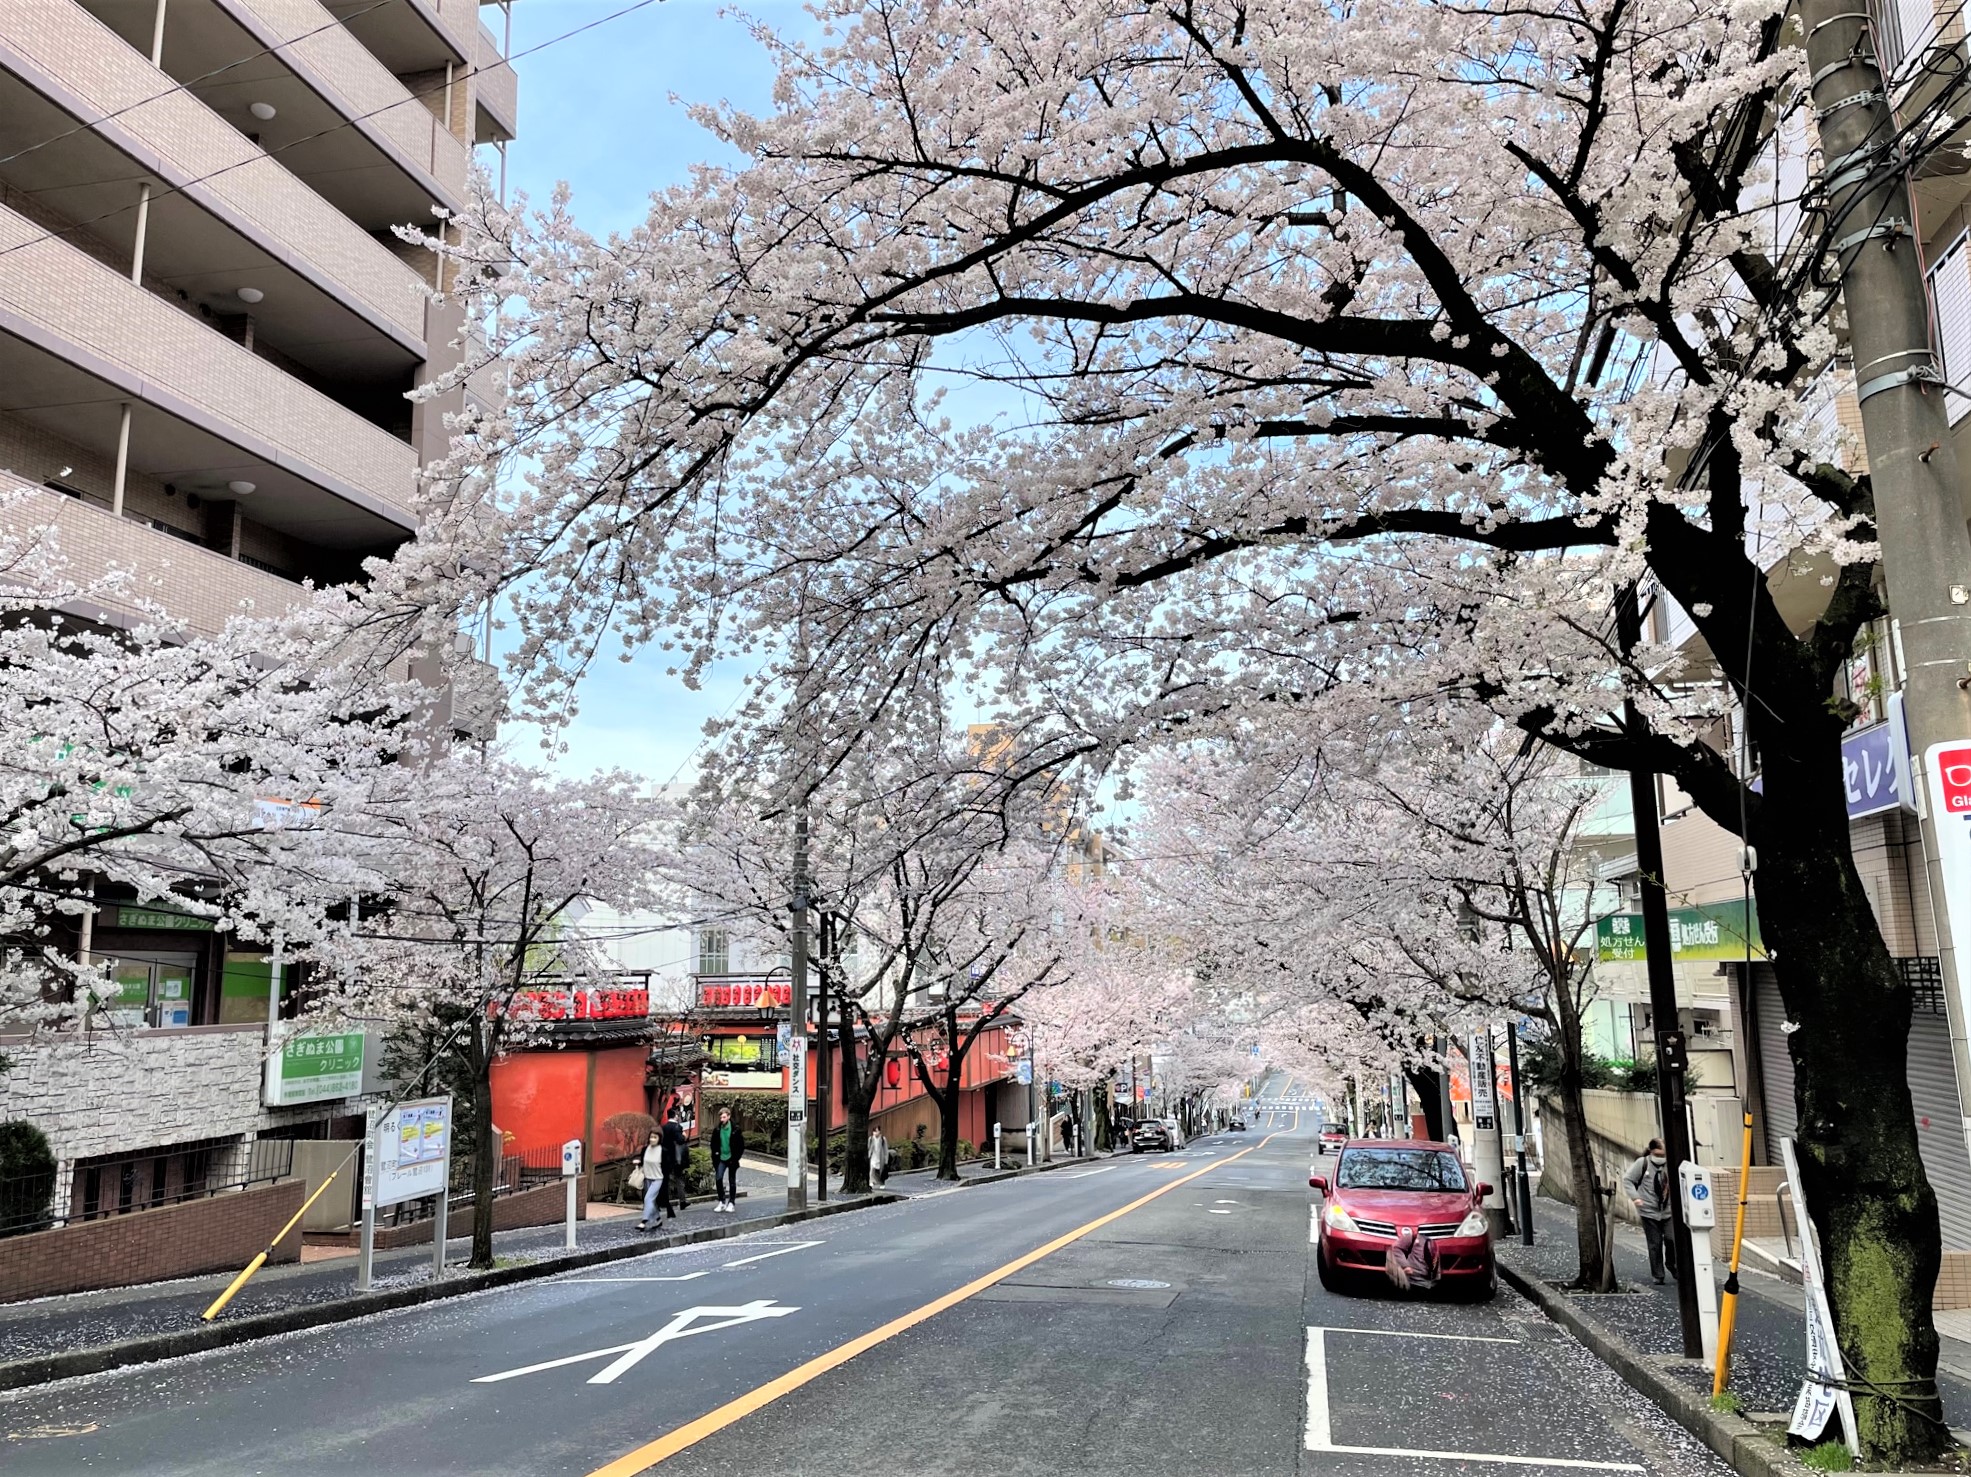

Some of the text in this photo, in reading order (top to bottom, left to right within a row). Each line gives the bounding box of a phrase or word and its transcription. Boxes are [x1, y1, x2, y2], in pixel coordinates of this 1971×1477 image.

[1600, 936, 1645, 948] 処方せん
[1611, 947, 1634, 959] 受付
[286, 1038, 344, 1058] さぎぬま公園
[320, 1056, 360, 1072] クリニック
[792, 1054, 800, 1093] 社交ダンス
